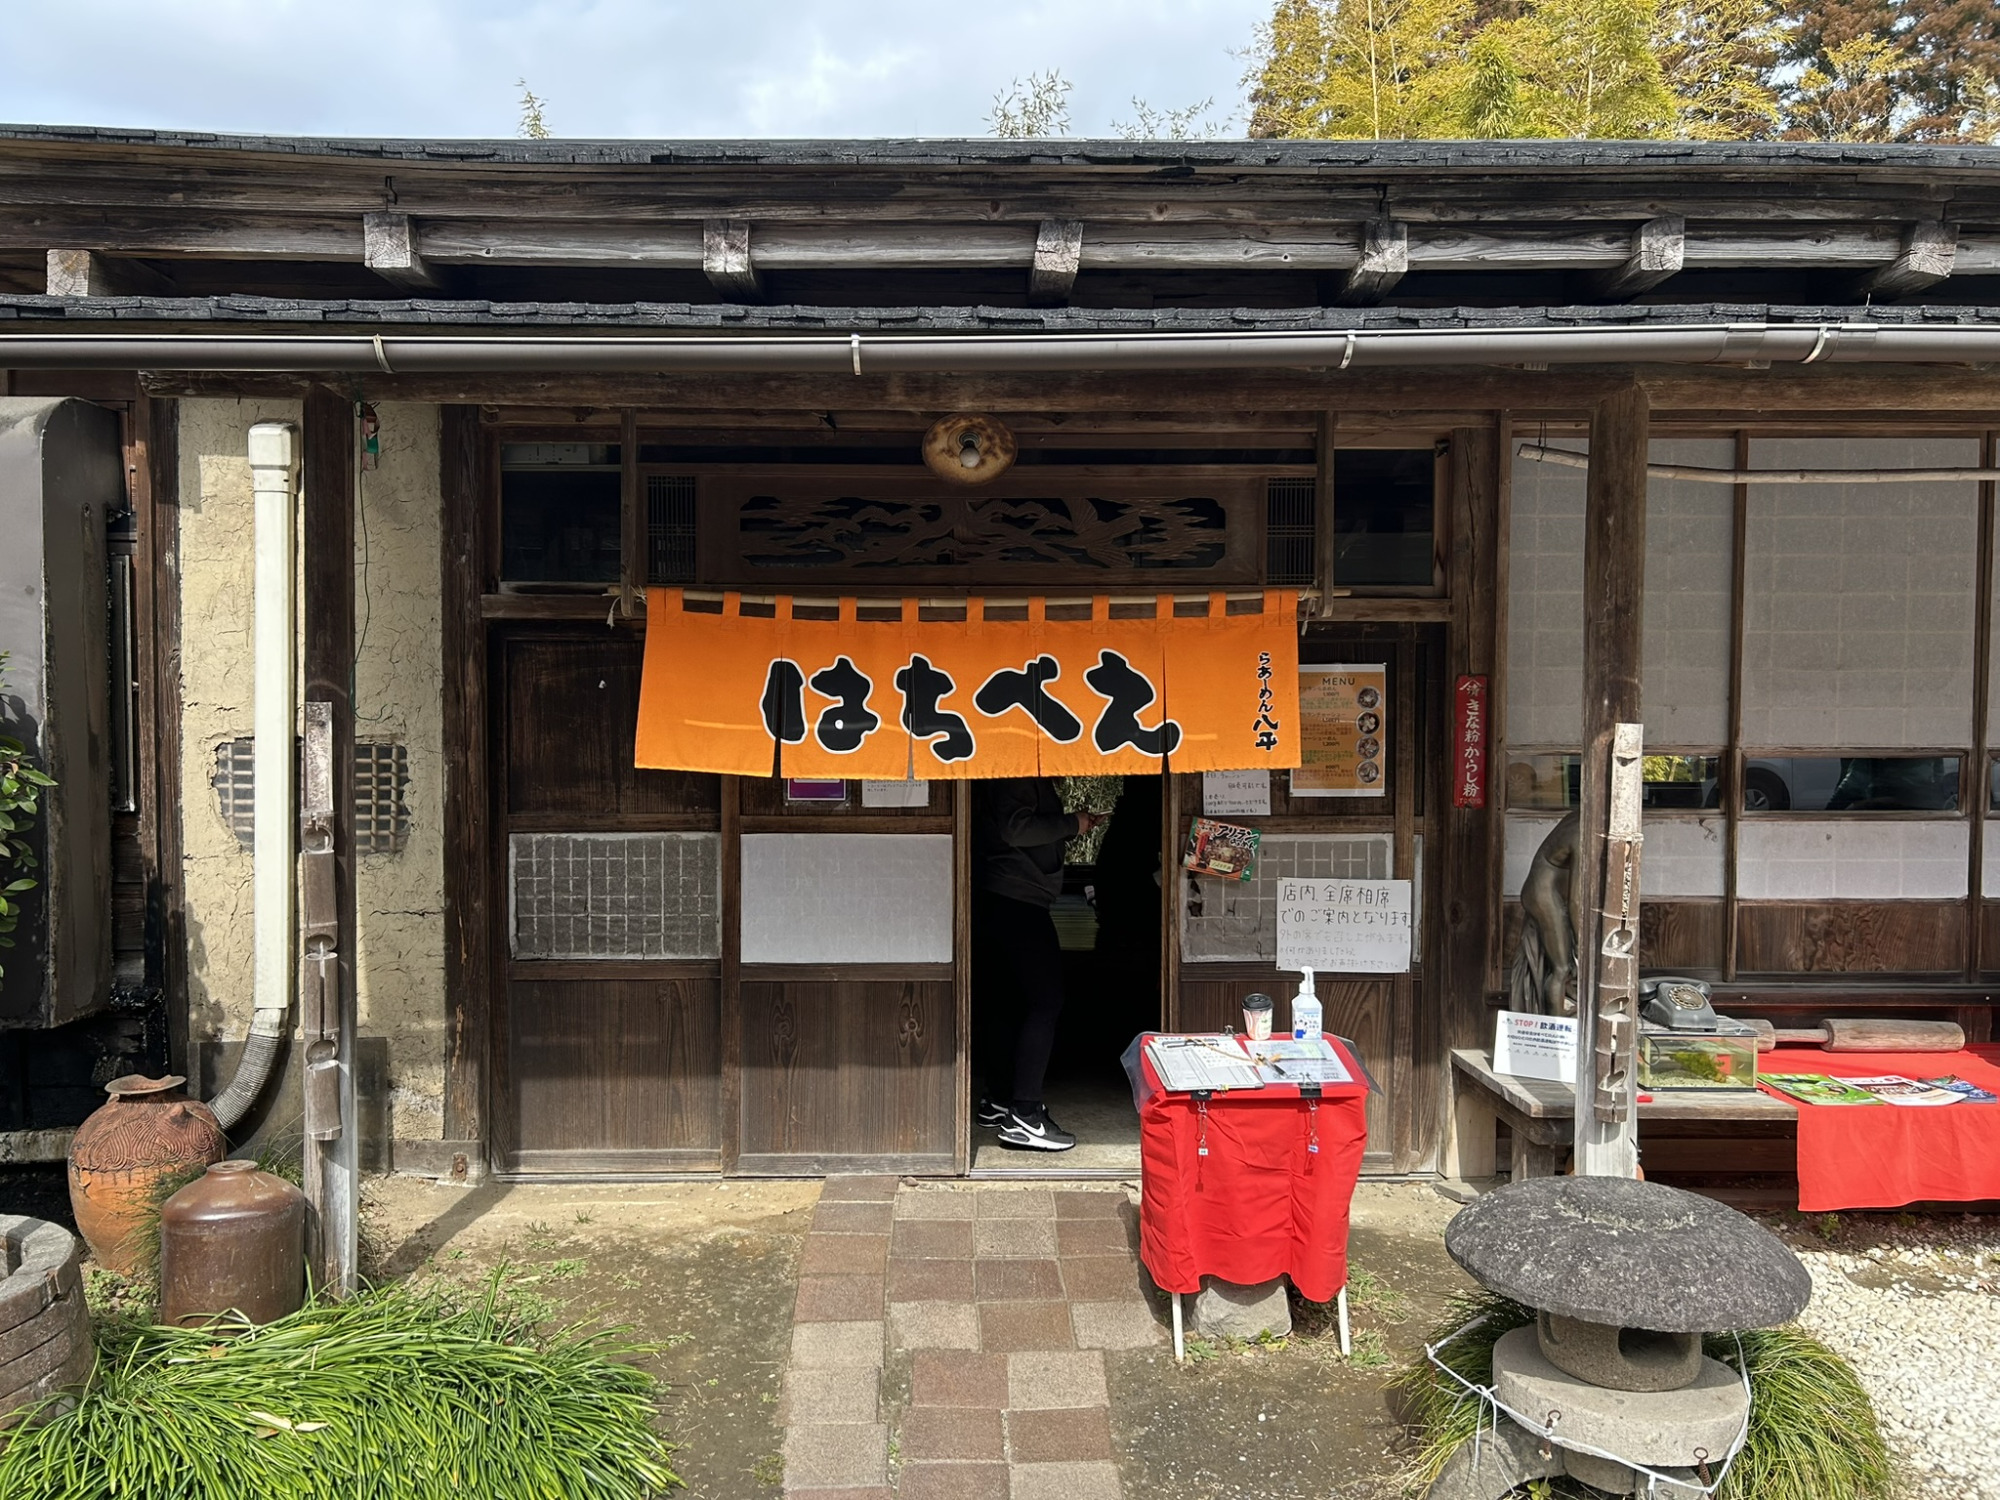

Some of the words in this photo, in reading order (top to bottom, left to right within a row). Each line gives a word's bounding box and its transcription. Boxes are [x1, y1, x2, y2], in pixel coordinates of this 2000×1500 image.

[1322, 677, 1356, 686] MENU
[761, 648, 1182, 763] はちべえ
[1218, 825, 1260, 841] アリラン
